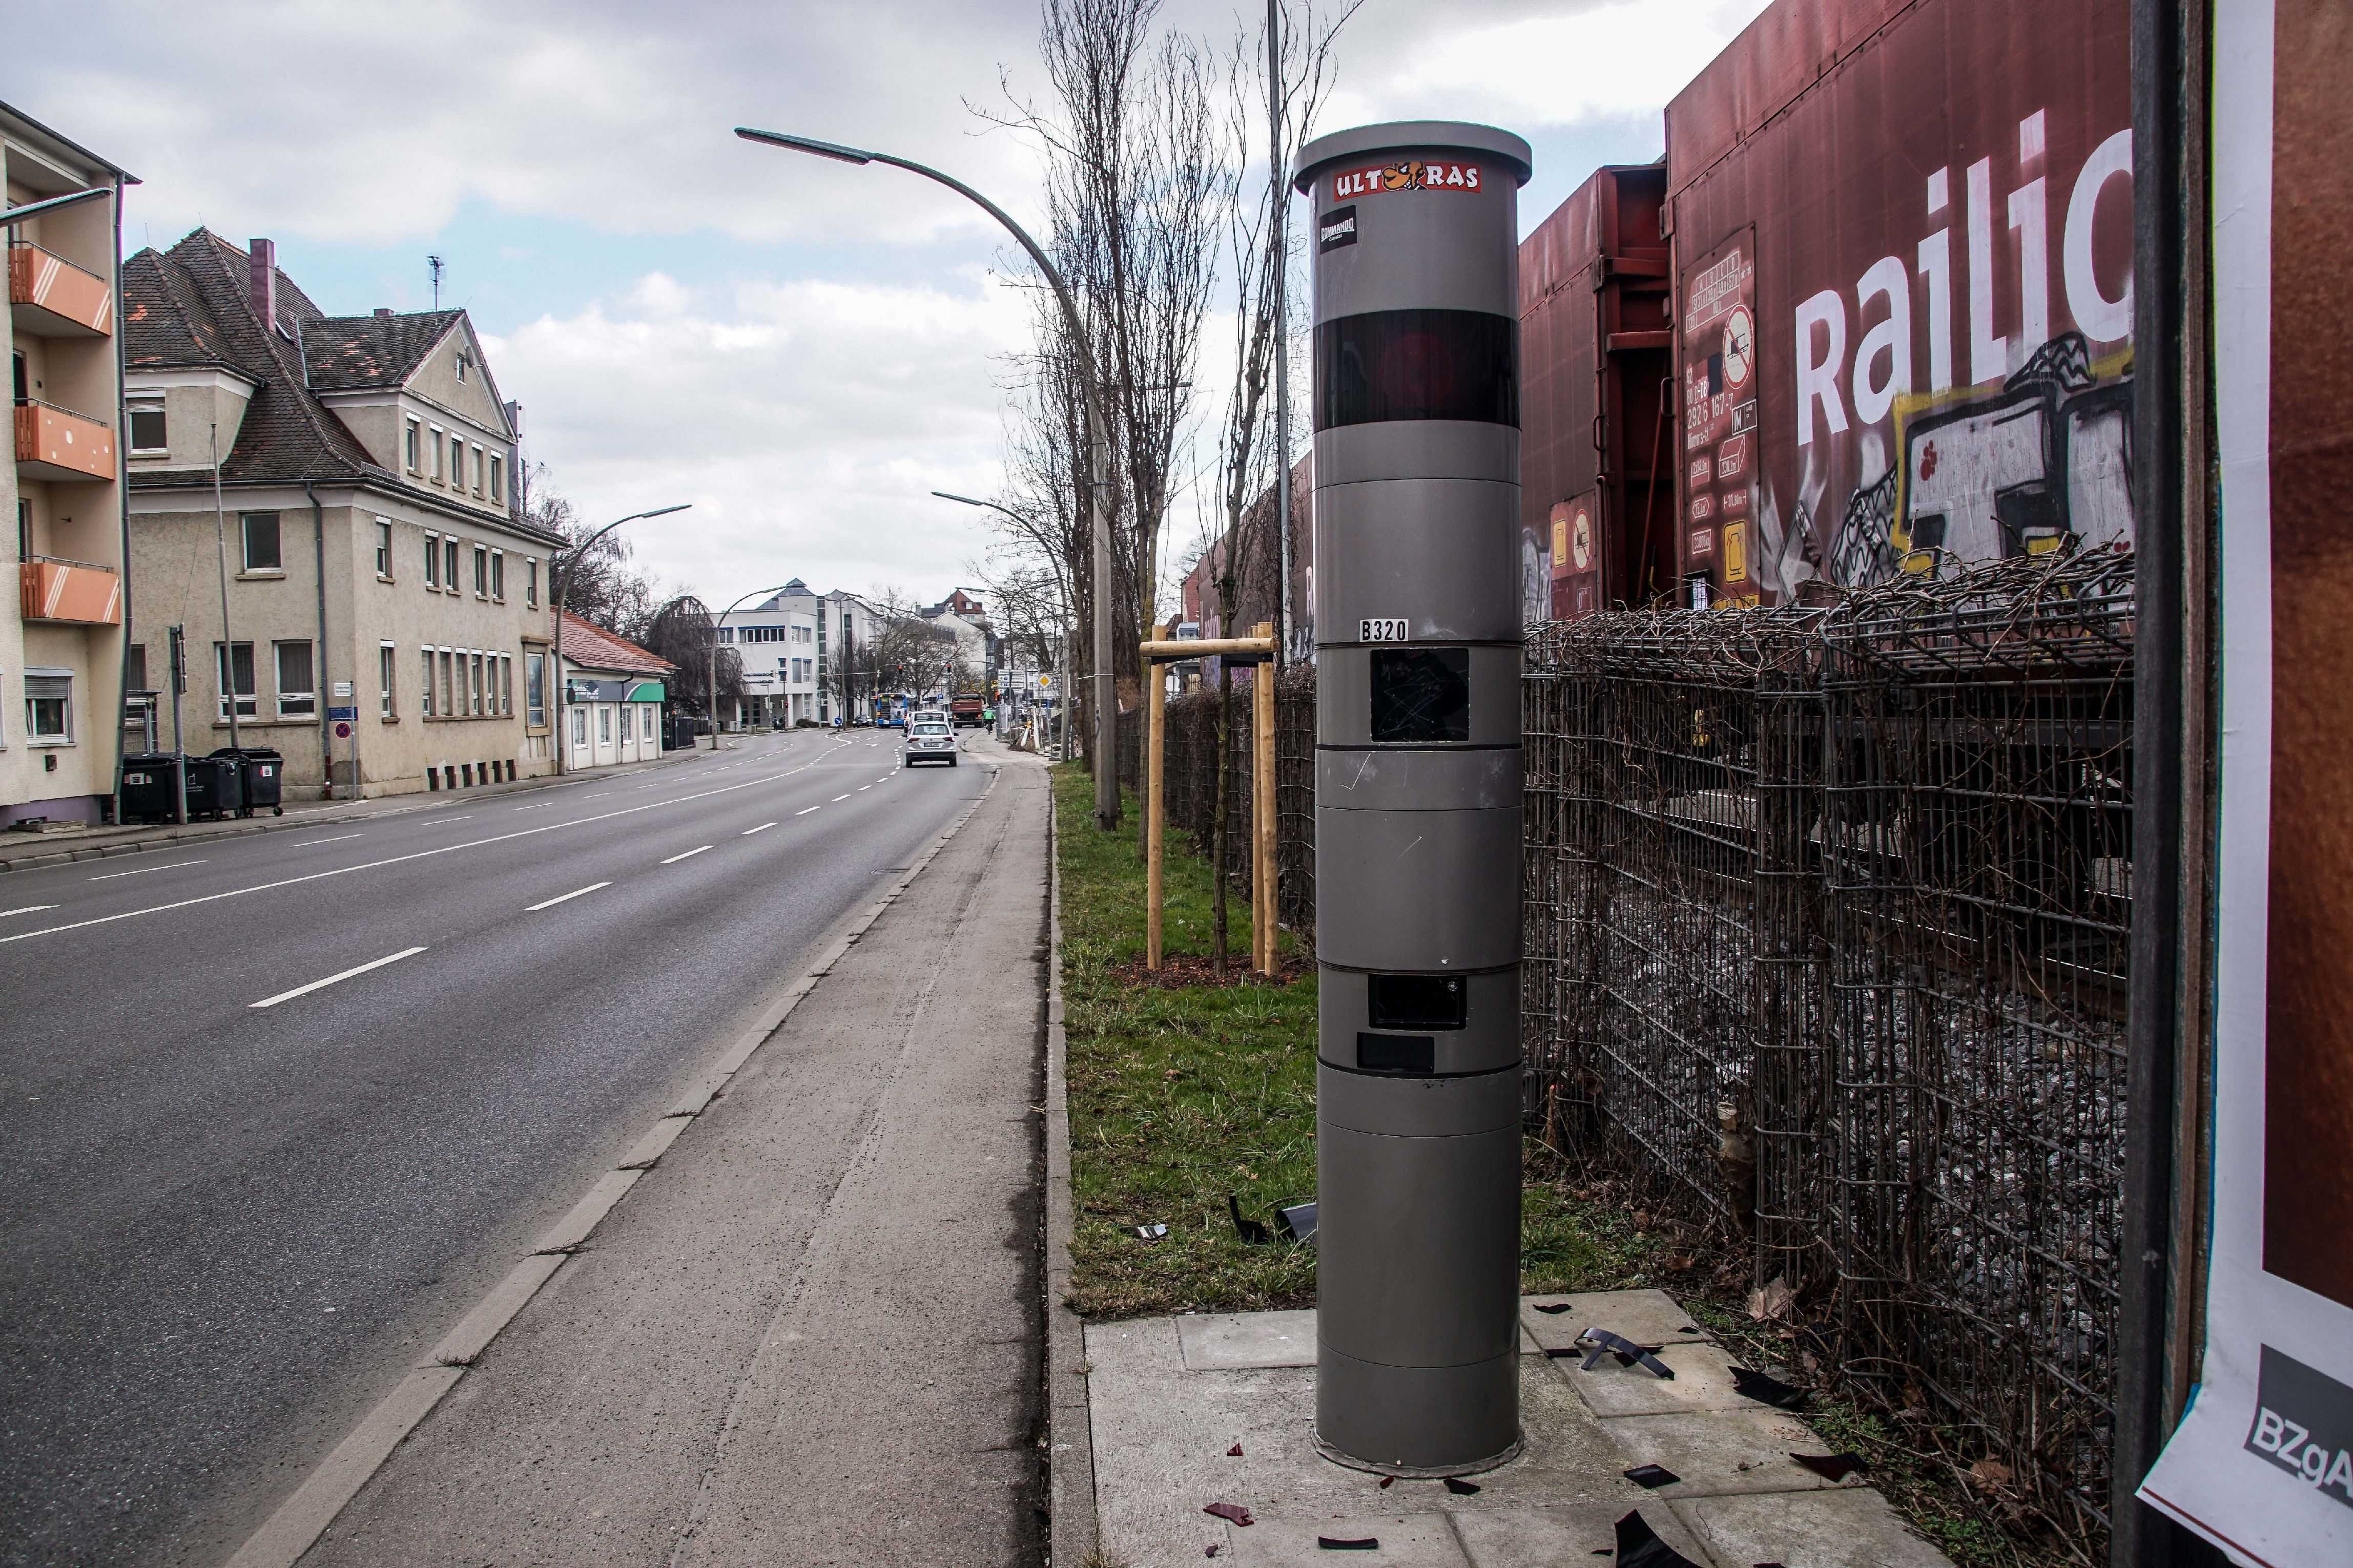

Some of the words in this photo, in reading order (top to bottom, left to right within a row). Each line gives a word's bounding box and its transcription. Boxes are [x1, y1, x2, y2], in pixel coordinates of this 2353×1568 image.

[1321, 217, 1354, 240] COMMANDO
[1687, 388, 1693, 405] 80
[1711, 392, 1733, 419] 167-7
[1362, 620, 1406, 641] B320
[2252, 1406, 2353, 1497] BZgA
